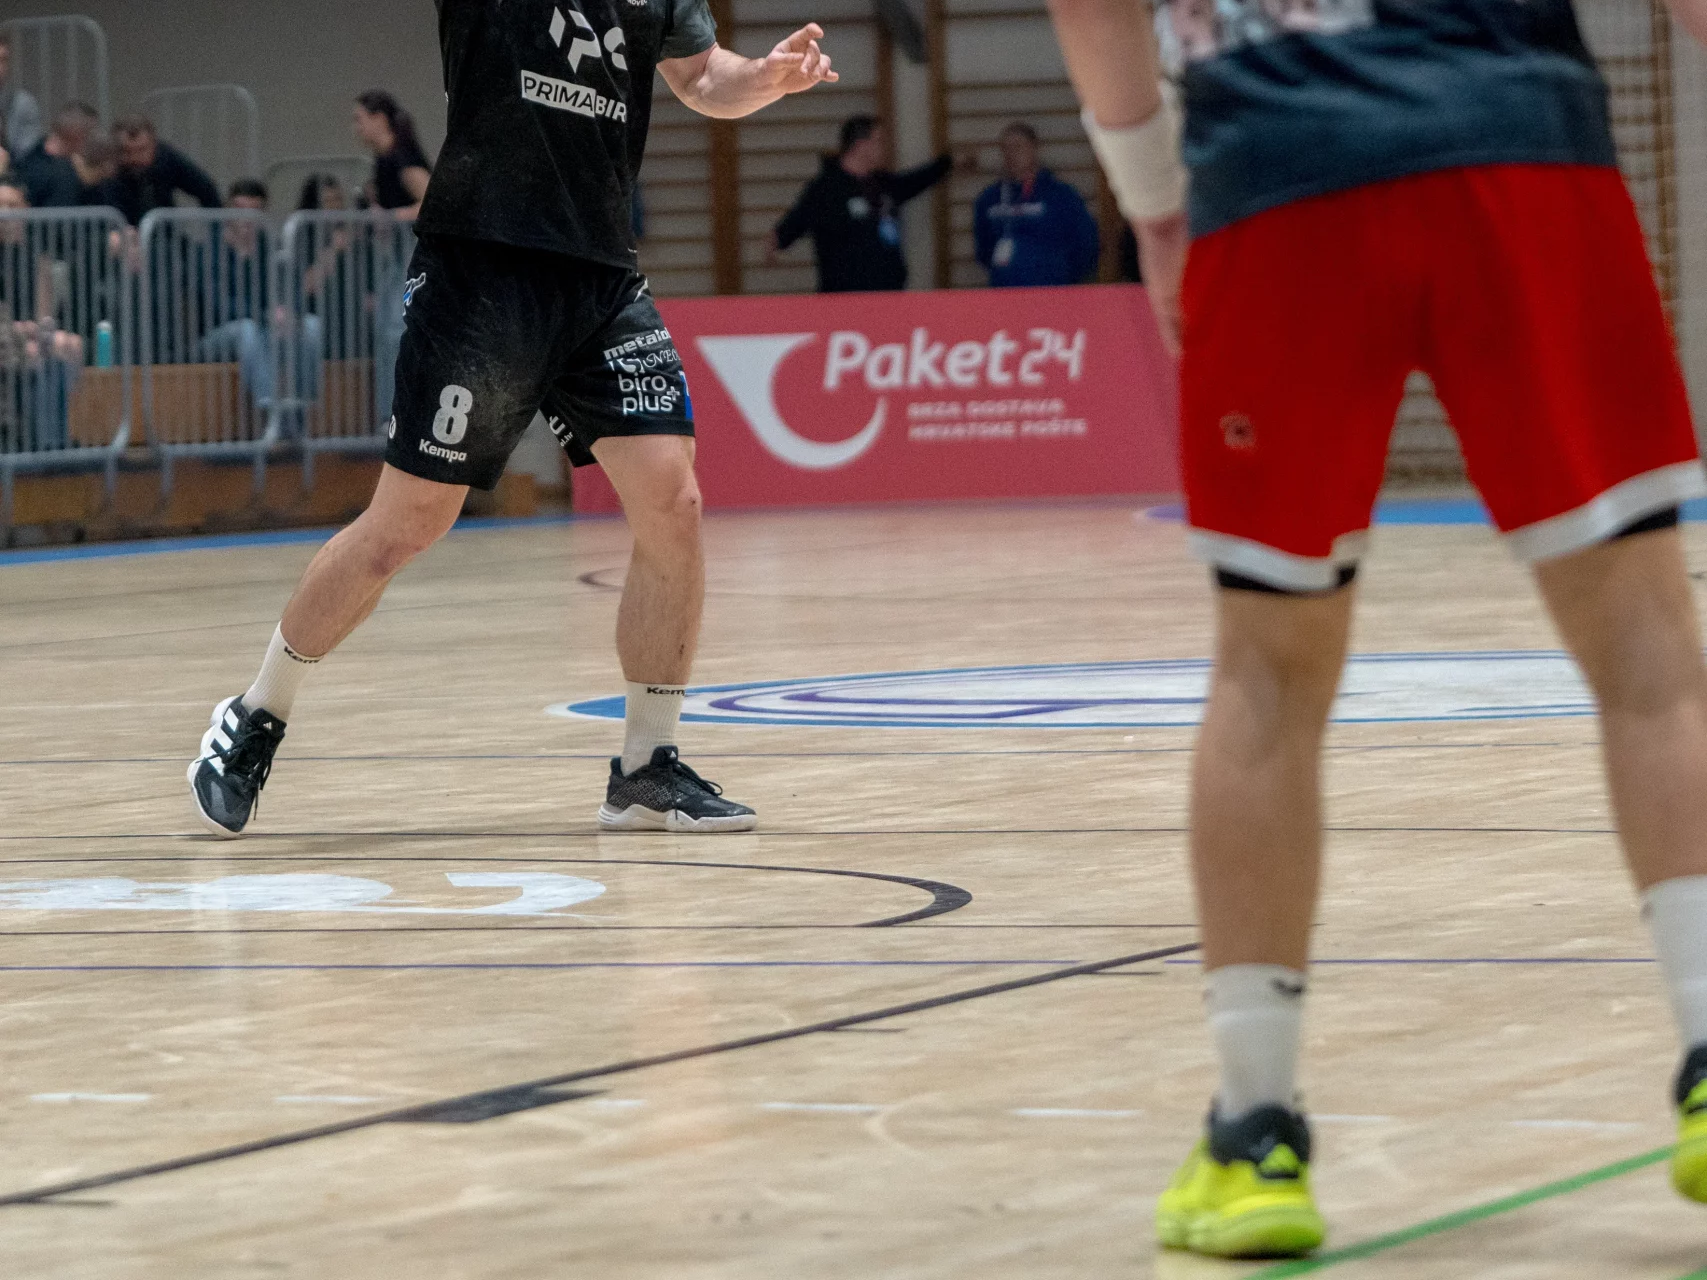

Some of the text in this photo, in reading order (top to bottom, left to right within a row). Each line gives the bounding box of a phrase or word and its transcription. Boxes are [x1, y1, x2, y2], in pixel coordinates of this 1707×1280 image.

[618, 370, 668, 393] biro
[432, 384, 473, 445] 8
[418, 438, 467, 463] Kempa
